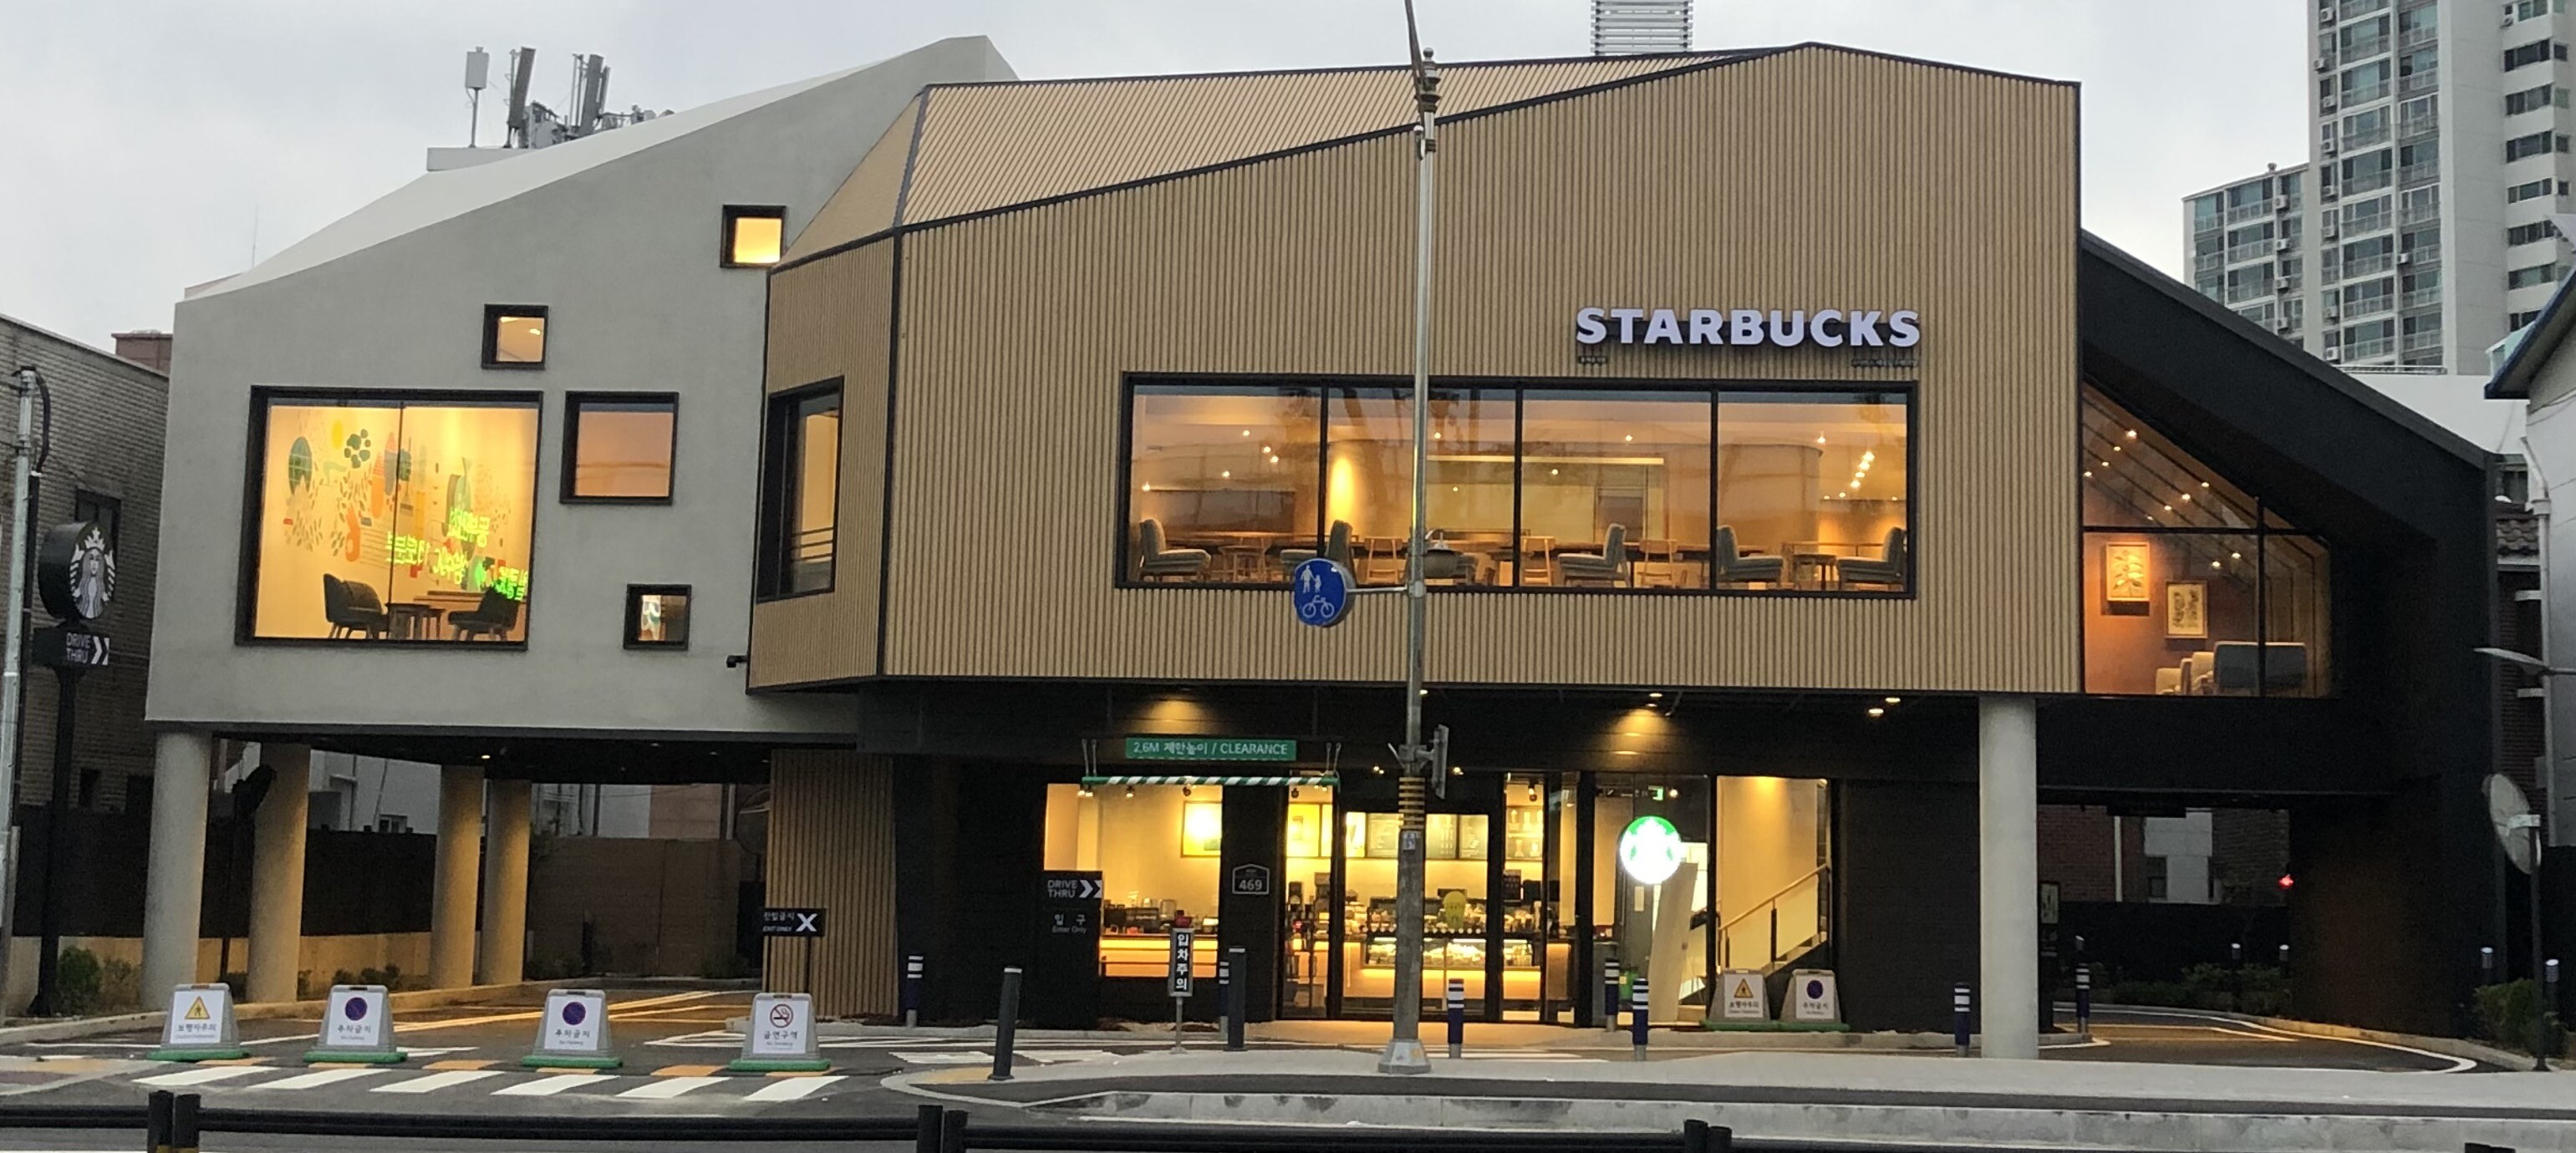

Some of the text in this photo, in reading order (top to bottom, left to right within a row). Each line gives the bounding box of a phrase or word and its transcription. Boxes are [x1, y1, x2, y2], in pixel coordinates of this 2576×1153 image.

[1576, 307, 1921, 347] STARBUCKS
[67, 632, 91, 648] DRIVE
[67, 648, 89, 663] THRU
[1133, 742, 1159, 754] 2.6M
[1163, 741, 1209, 755] 제한높이
[1219, 742, 1289, 755] CLEARANCE
[1047, 879, 1078, 890] DRIVE
[1238, 879, 1263, 891] 469
[1048, 889, 1077, 899] THRU
[1175, 933, 1189, 991] 입차주의
[337, 1024, 372, 1034] 주차금지
[554, 1029, 591, 1039] 주차금지
[763, 1030, 799, 1040] 금연구역
